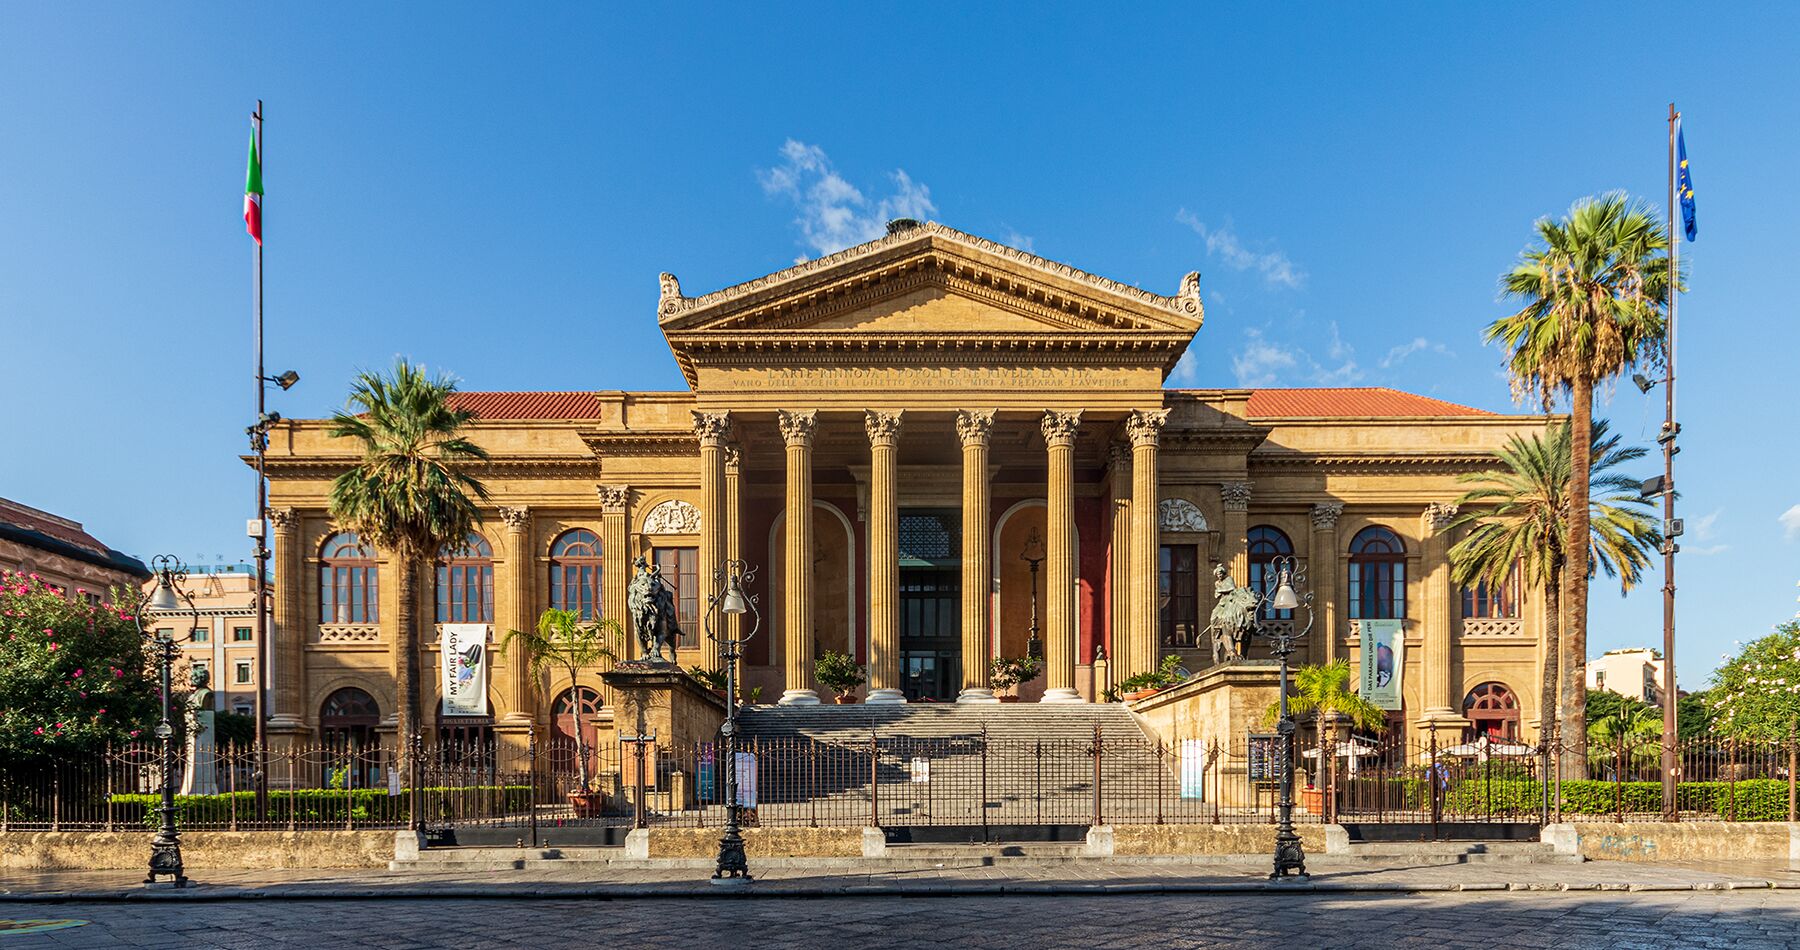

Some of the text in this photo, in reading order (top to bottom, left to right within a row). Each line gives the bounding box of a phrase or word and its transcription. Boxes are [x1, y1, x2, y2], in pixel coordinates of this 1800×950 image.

[820, 369, 879, 379] RINNOVA
[898, 369, 942, 379] POPOLI
[950, 369, 957, 379] E
[963, 369, 980, 379] NE
[988, 369, 1033, 379] RIVELA
[1041, 369, 1055, 379] LA
[1064, 369, 1093, 379] VITA
[733, 379, 762, 387] VANO
[768, 379, 797, 387] DELLE
[804, 379, 839, 387] SCENE
[846, 379, 857, 387] IL
[863, 379, 905, 387] DILETTO
[912, 379, 933, 387] OVE
[940, 379, 961, 387] NON
[971, 379, 994, 387] MIRI
[1012, 379, 1064, 387] PREPARAR
[449, 632, 458, 656] LADY
[450, 680, 458, 695] MY
